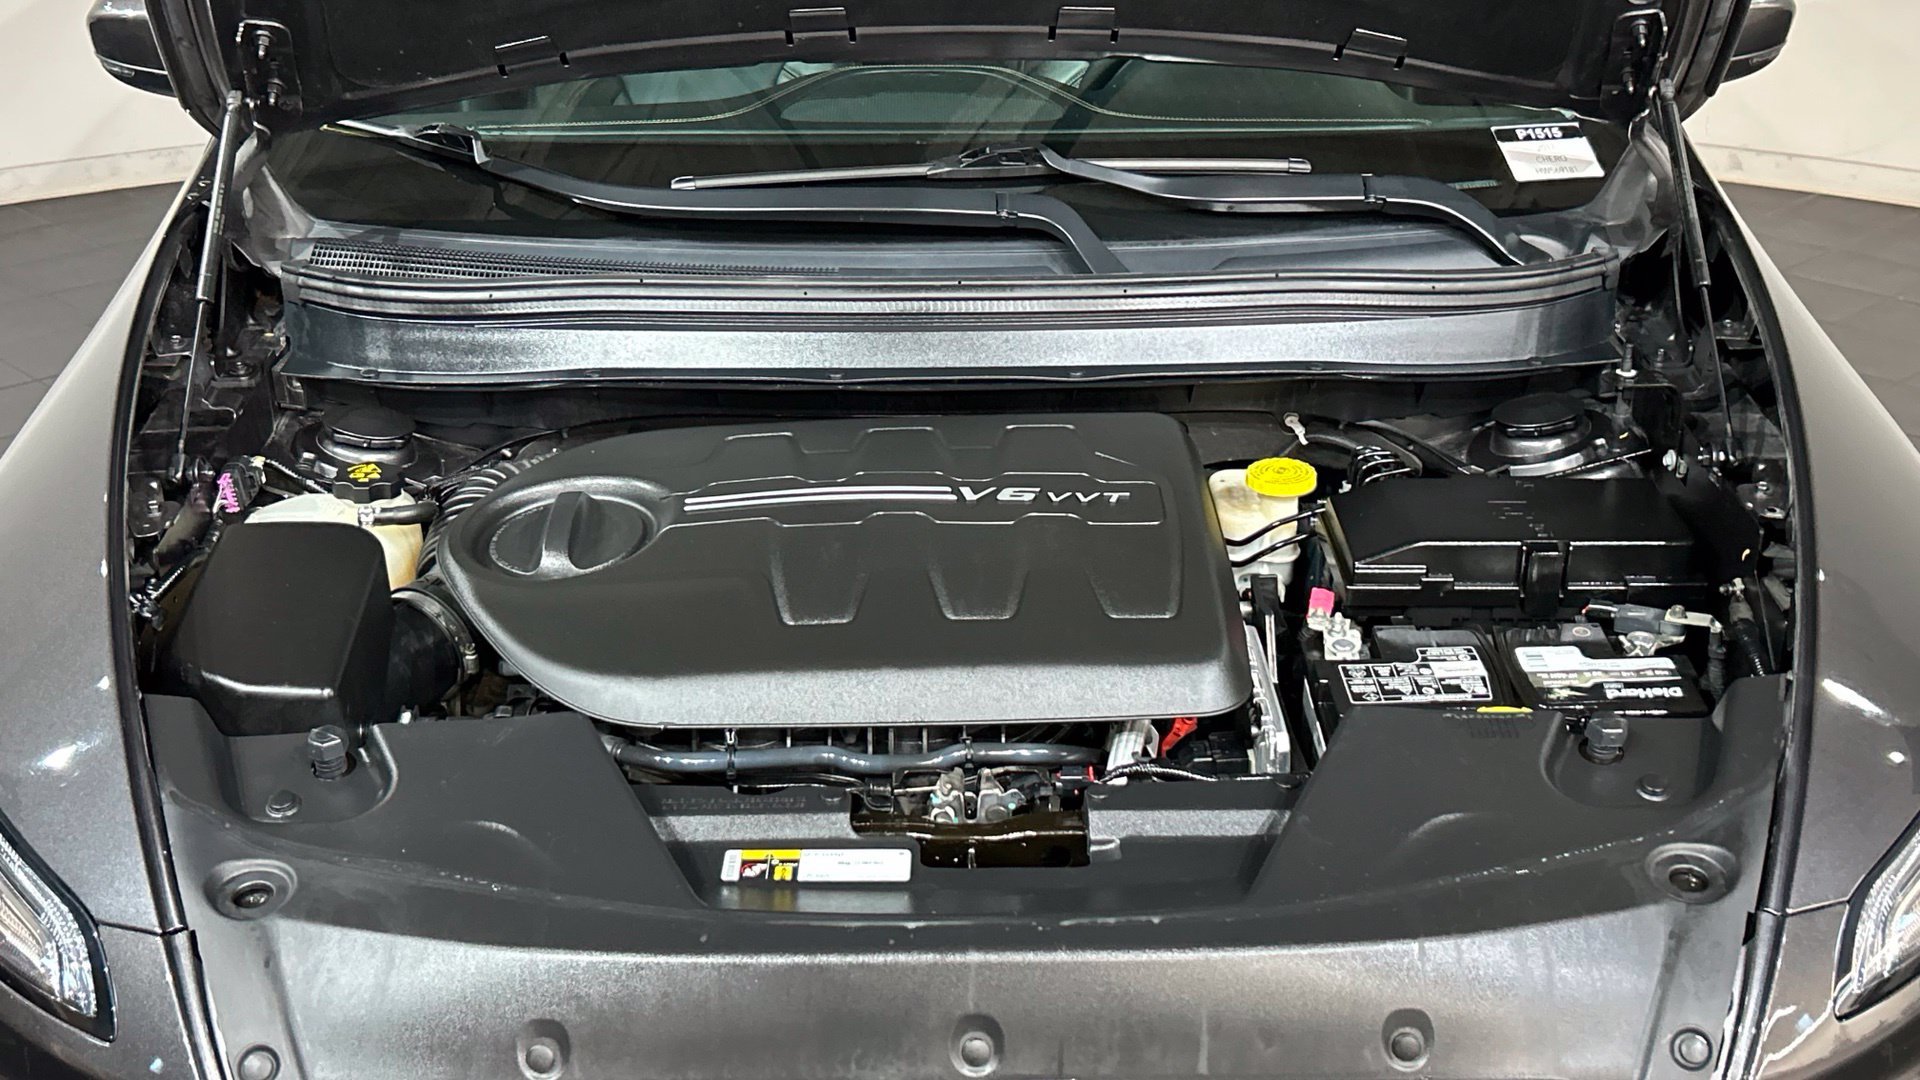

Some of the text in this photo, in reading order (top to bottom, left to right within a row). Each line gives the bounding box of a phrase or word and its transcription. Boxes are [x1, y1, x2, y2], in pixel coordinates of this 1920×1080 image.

[1515, 127, 1563, 140] P1515
[958, 486, 1131, 503] V6 VVT
[1605, 686, 1684, 699] DieHard
